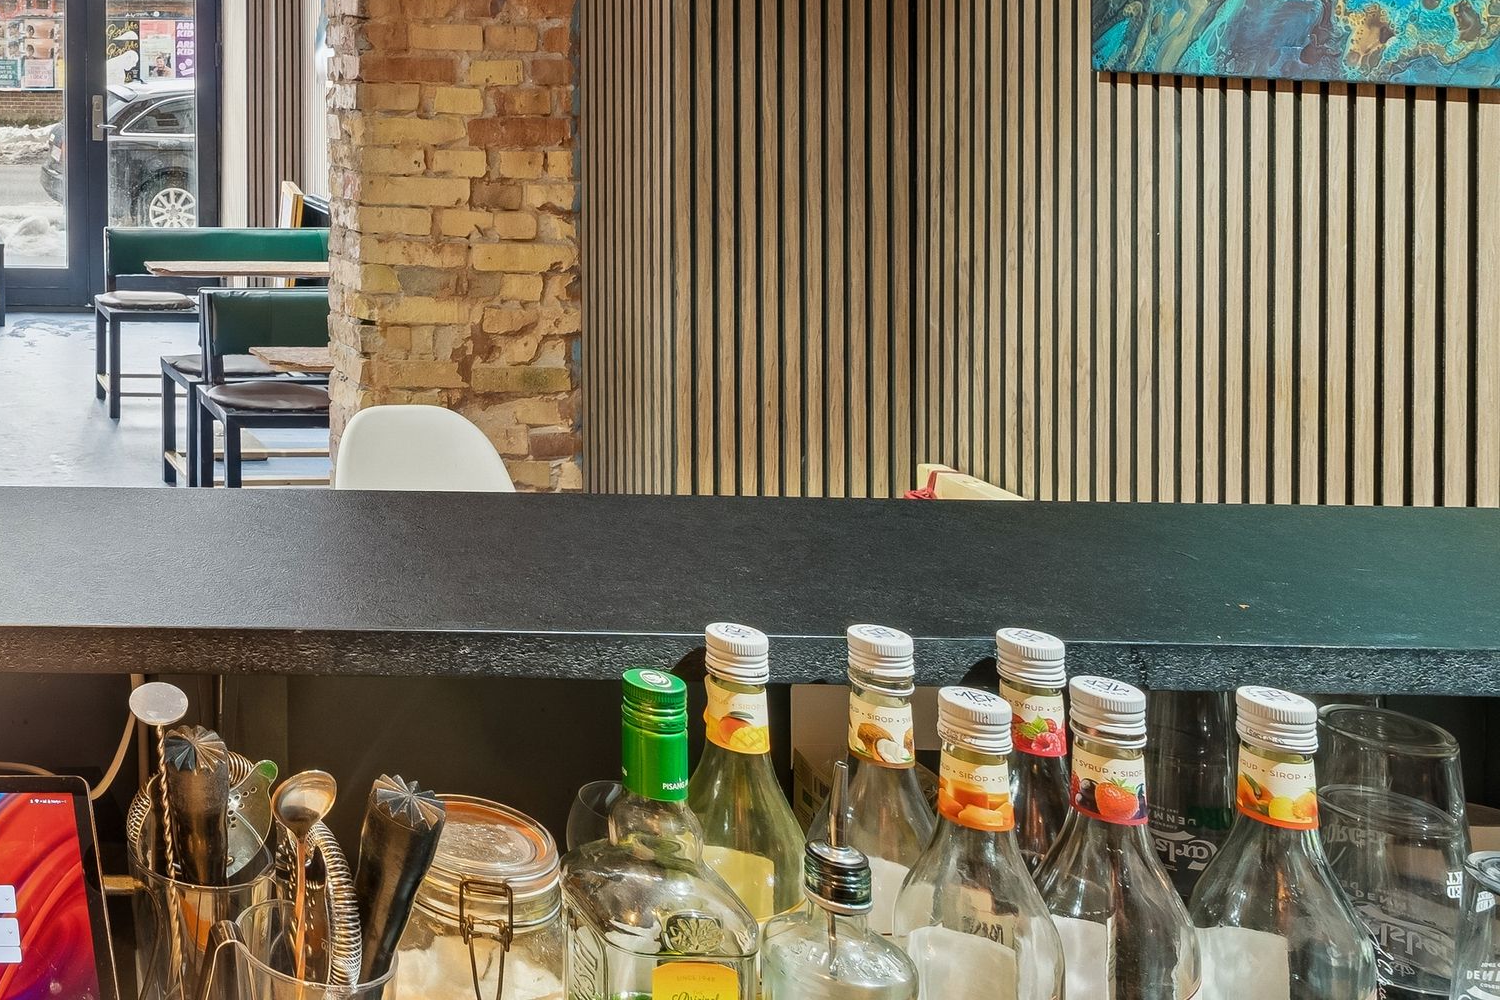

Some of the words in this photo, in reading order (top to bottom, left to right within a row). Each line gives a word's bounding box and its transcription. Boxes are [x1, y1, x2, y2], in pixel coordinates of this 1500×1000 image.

[1079, 760, 1110, 775] SYRUP
[959, 770, 989, 783] SIROP
[1269, 769, 1301, 781] SIROP
